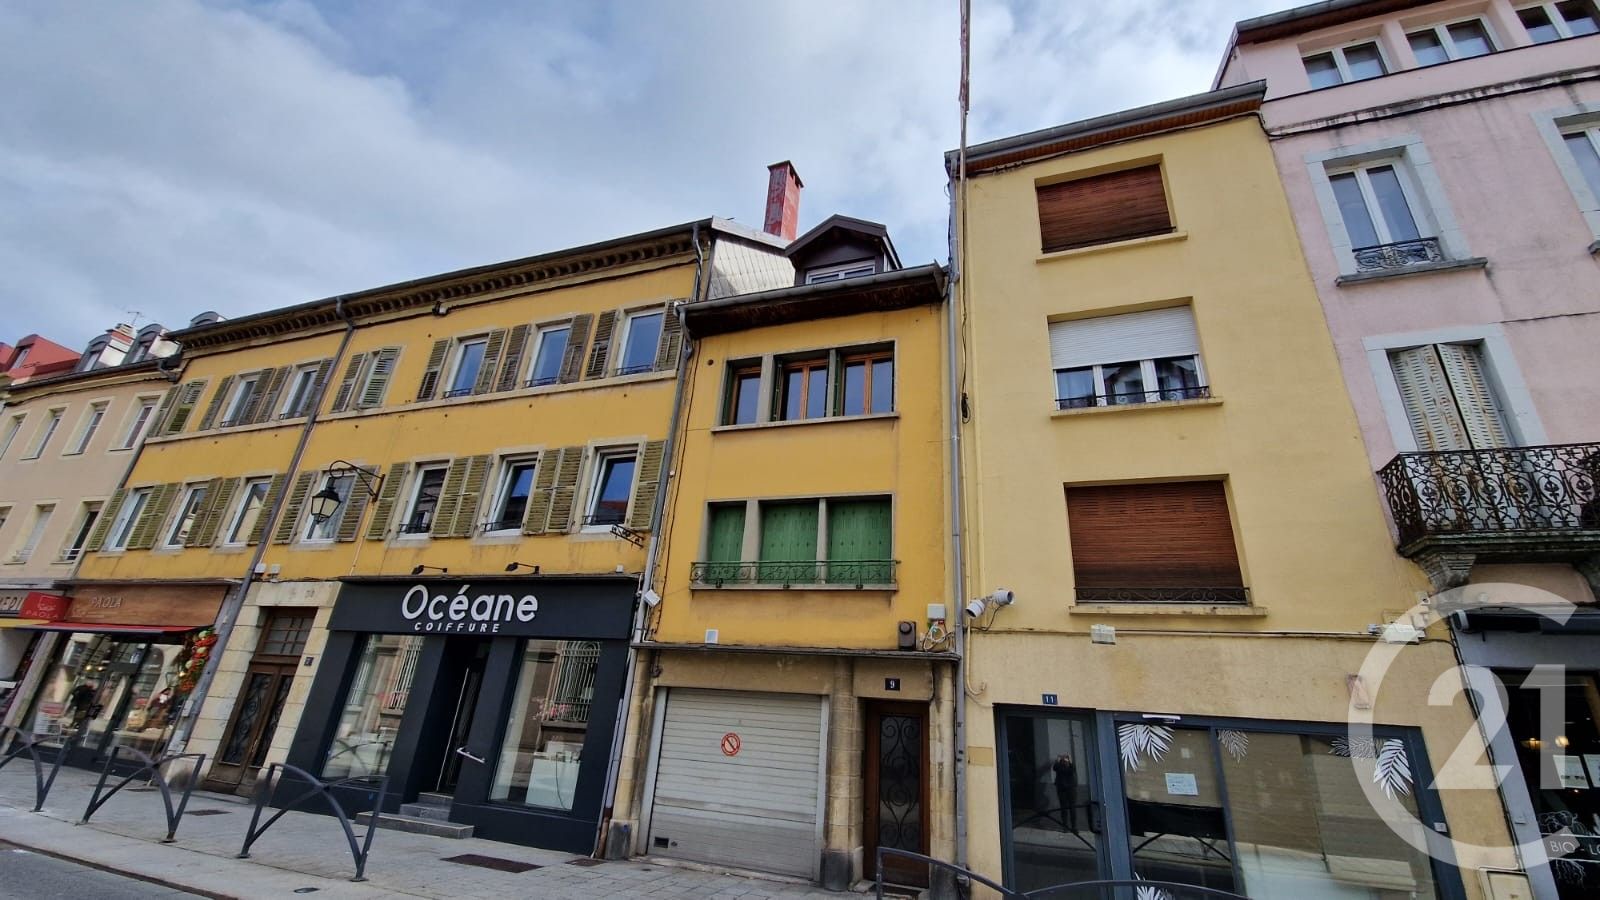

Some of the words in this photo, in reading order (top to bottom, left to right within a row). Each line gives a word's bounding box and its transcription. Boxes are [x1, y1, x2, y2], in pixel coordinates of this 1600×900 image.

[402, 584, 538, 622] Océane
[414, 622, 500, 633] COIFFURE
[1045, 695, 1054, 704] 11
[1550, 840, 1576, 854] BIO
